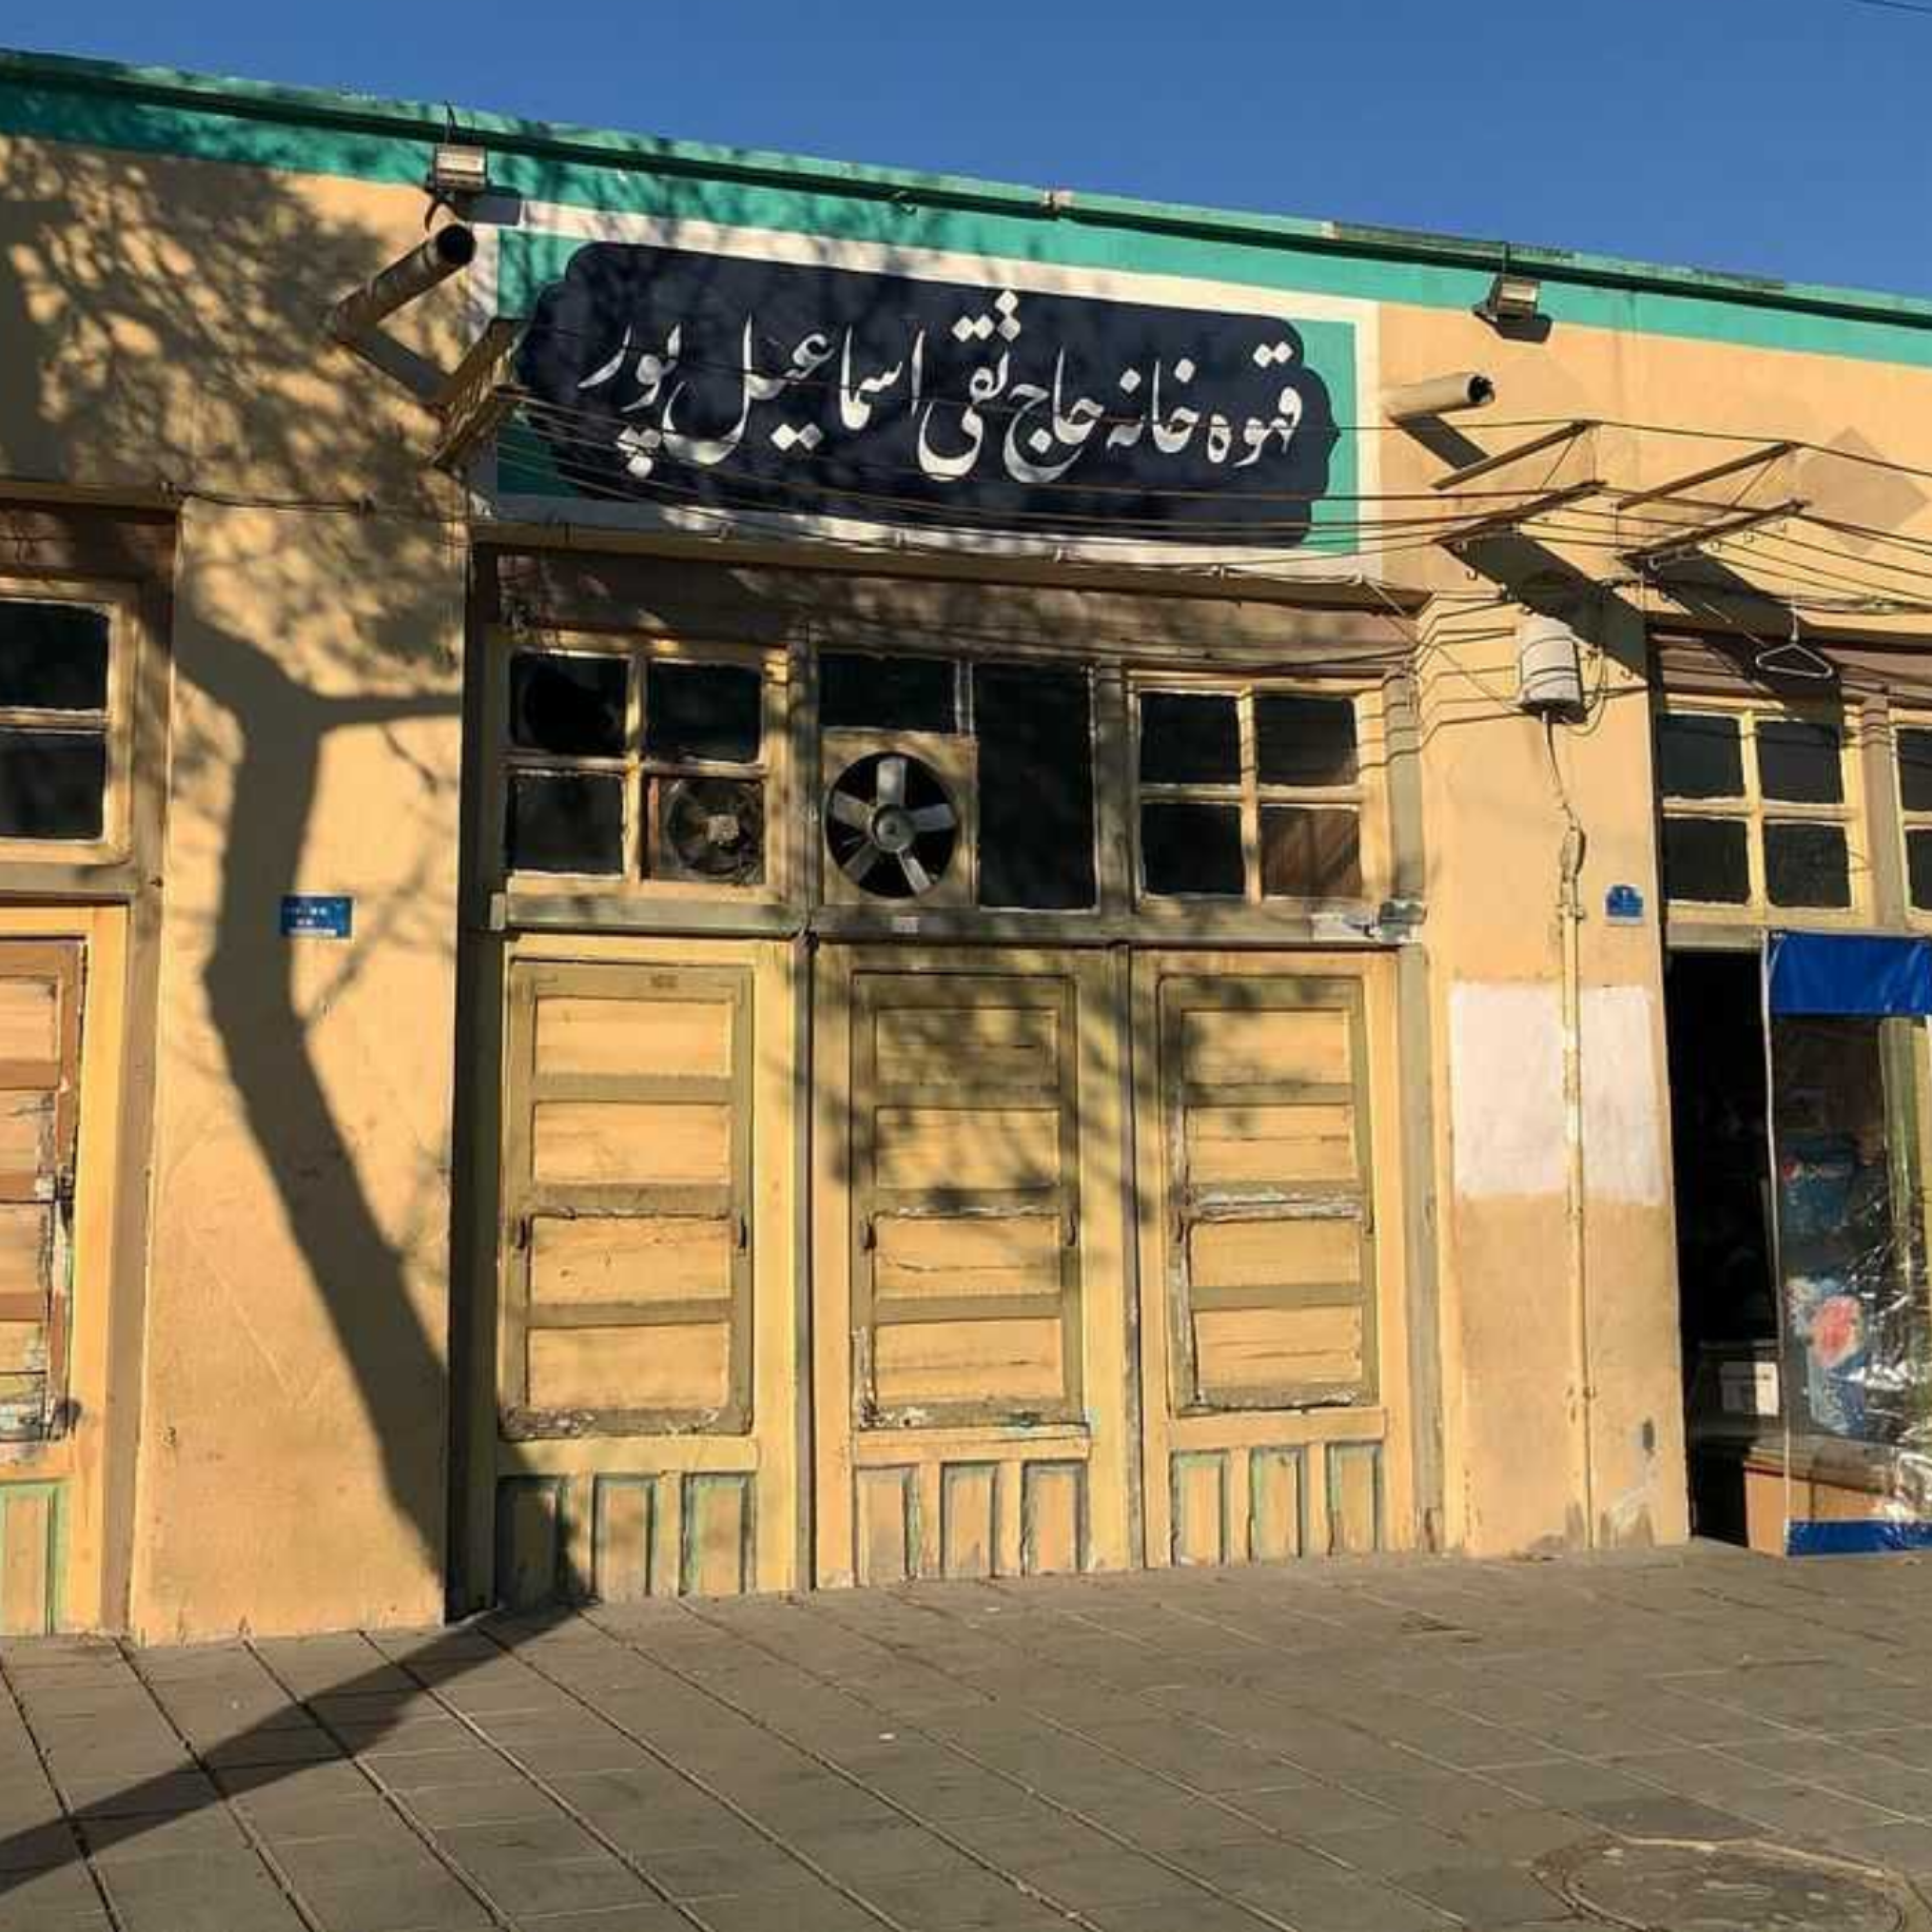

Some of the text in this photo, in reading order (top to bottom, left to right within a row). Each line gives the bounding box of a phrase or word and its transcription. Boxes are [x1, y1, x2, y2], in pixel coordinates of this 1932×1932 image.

[578, 289, 1302, 484] قهوه خانه حاج تقی اسماعیل پور
